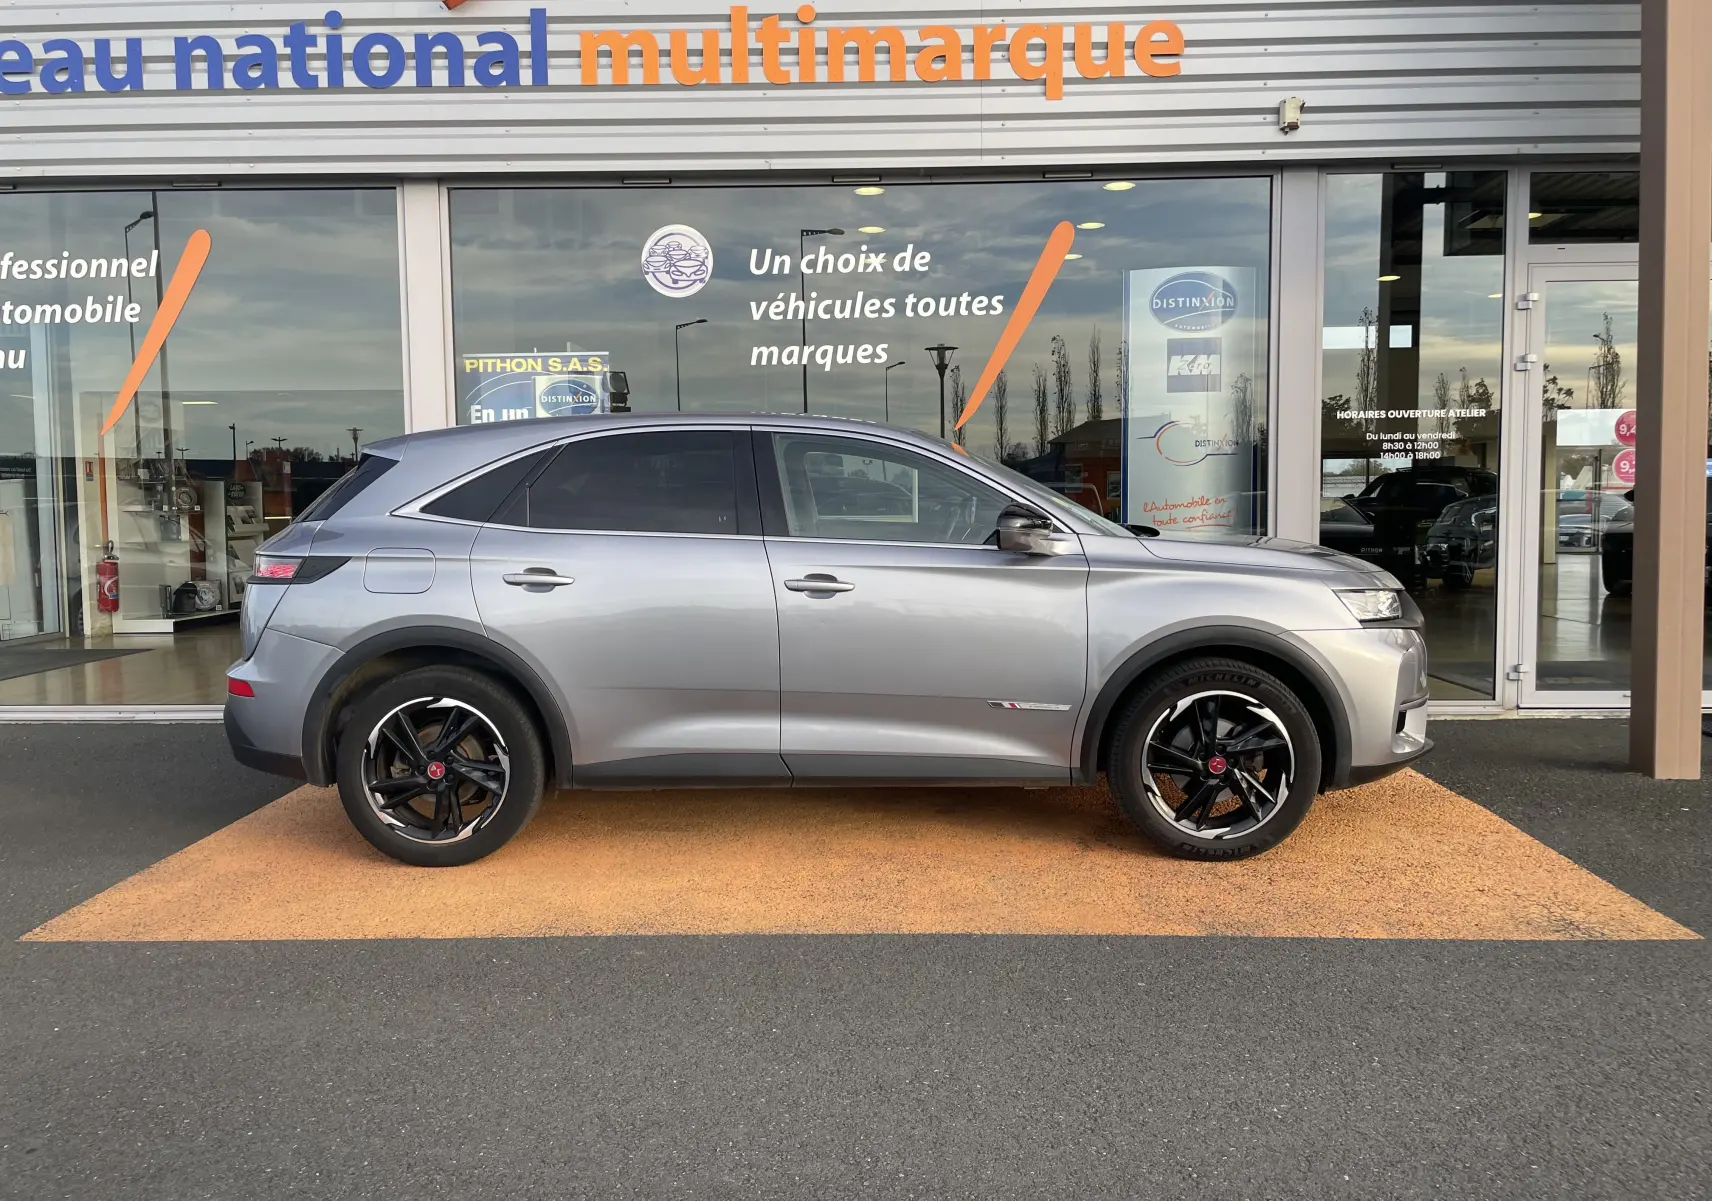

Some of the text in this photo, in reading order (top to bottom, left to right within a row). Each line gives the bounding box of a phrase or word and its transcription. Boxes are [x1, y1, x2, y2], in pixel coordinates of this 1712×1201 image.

[174, 8, 548, 90] national
[580, 5, 1185, 100] multimarque
[0, 250, 158, 280] fessionnel
[750, 244, 931, 275] Un choix de
[750, 291, 1004, 320] véhicules toutes
[1152, 293, 1234, 309] DISTINXION
[1, 295, 141, 325] tomobile
[0, 350, 26, 369] u
[465, 356, 609, 373] PITHON S.A.S.
[750, 343, 888, 372] marques
[541, 393, 597, 404] DISTINXION
[471, 405, 495, 424] En
[1337, 409, 1486, 419] HORAIRES OUVERTURE ATELIER
[1195, 437, 1239, 449] DISTINXION
[1366, 432, 1378, 440] Du
[1380, 432, 1402, 440] lundi
[1417, 432, 1456, 440] vendredi
[1382, 442, 1404, 450] 8h30
[1380, 452, 1406, 460] 14h00
[1152, 509, 1234, 526] toute confiance
